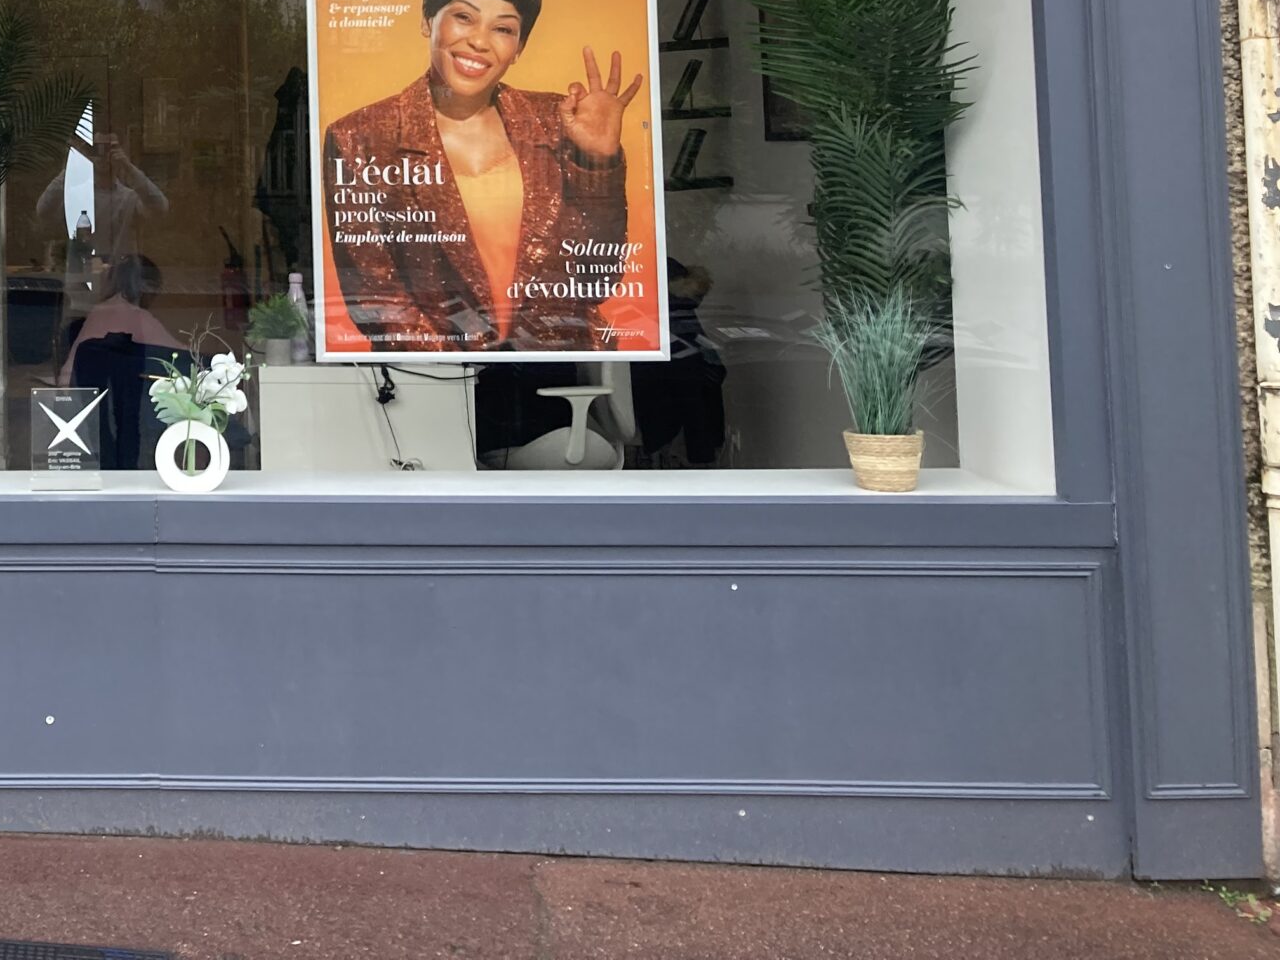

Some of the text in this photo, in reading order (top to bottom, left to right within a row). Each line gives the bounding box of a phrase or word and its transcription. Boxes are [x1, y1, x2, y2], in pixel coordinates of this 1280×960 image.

[329, 3, 411, 15] & repassage
[329, 16, 395, 28] à domicile
[334, 156, 446, 186] L'éclat
[334, 189, 387, 204] d'une
[335, 207, 437, 227] profession
[335, 231, 467, 246] Employé de maison
[559, 239, 643, 261] Solange
[565, 261, 643, 274] Un modèle
[506, 275, 644, 299] d'évolution
[595, 318, 645, 344] Harcourt
